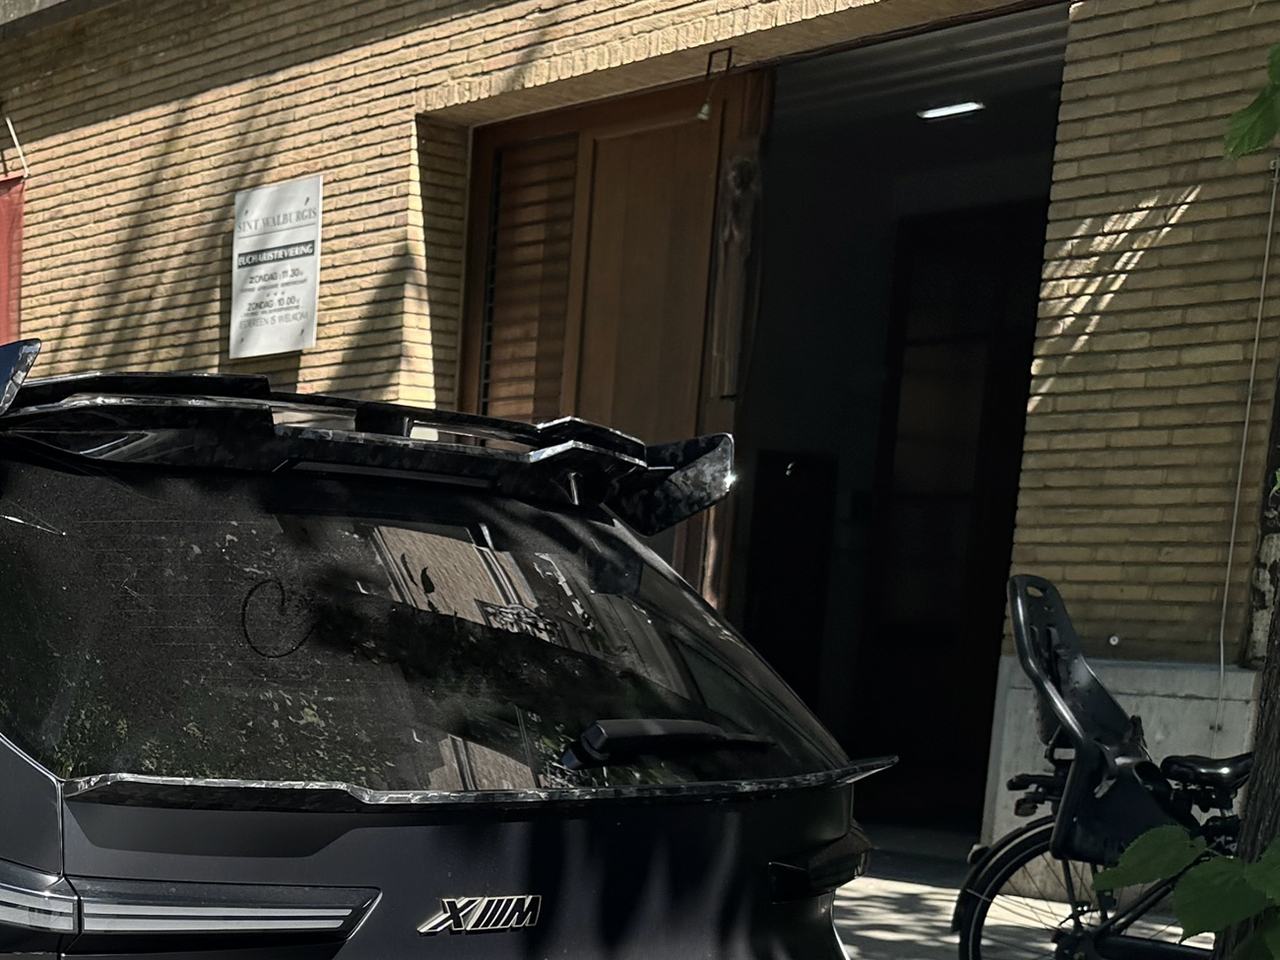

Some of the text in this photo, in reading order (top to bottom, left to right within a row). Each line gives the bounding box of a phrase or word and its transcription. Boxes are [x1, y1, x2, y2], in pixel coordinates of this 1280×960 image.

[262, 208, 317, 228] WALBURGIS
[249, 271, 278, 284] ZONDAG
[247, 299, 274, 312] ZONDAG
